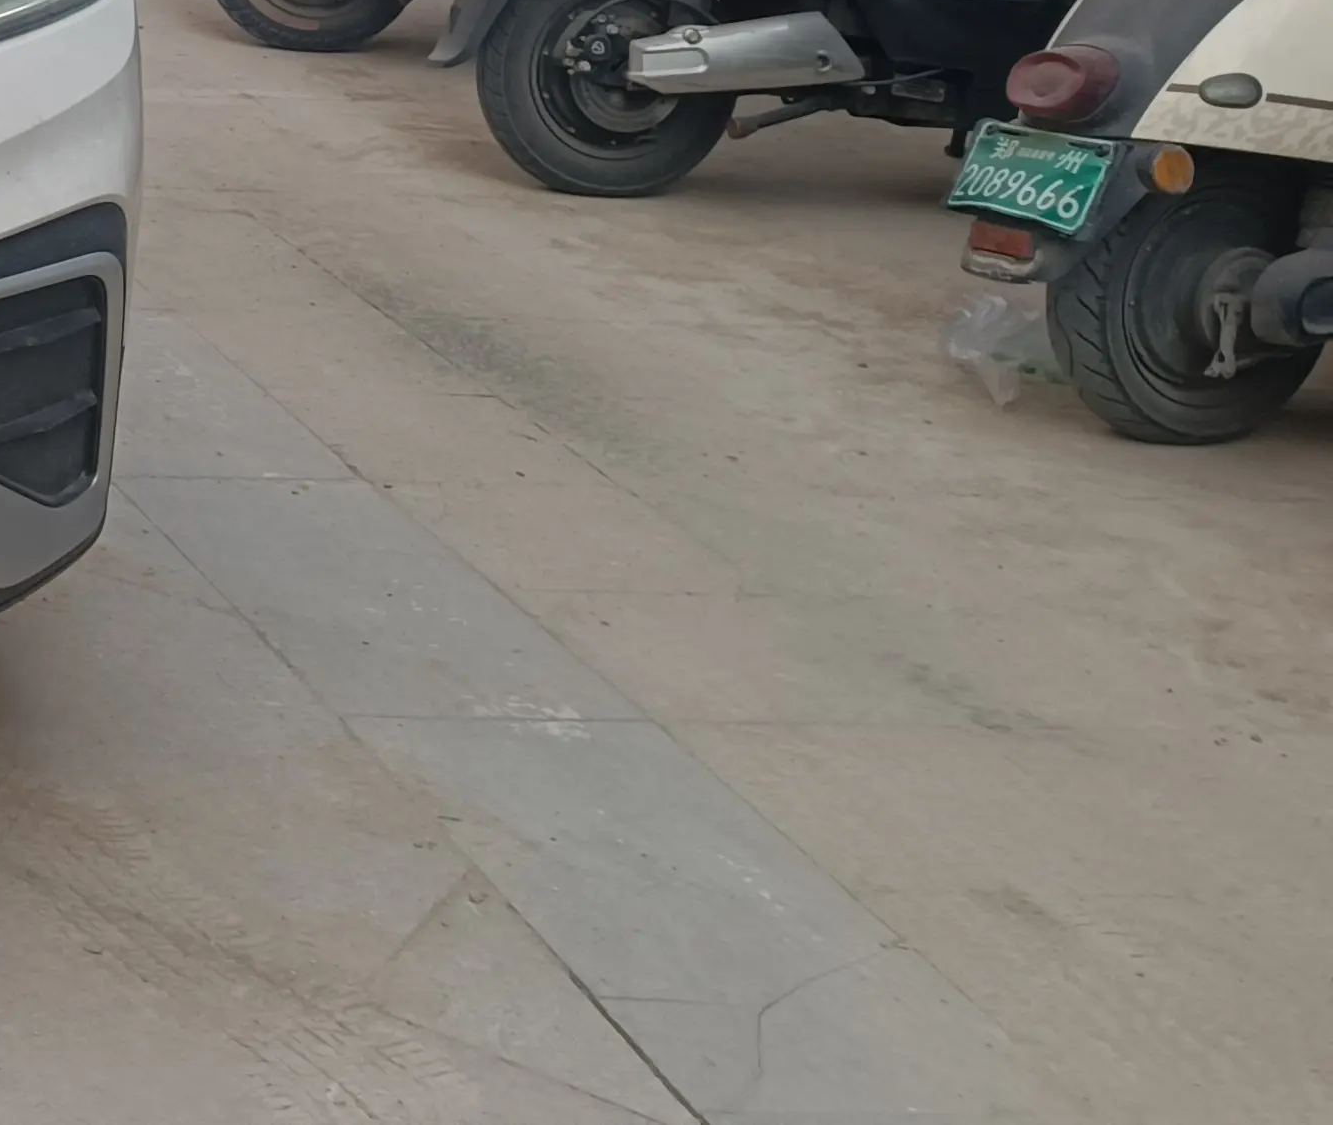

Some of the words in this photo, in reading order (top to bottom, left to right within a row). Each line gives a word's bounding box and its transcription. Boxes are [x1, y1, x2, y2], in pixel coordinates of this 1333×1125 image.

[989, 136, 1021, 161] 郑
[1054, 149, 1089, 175] 州
[952, 163, 1085, 219] 2089666
